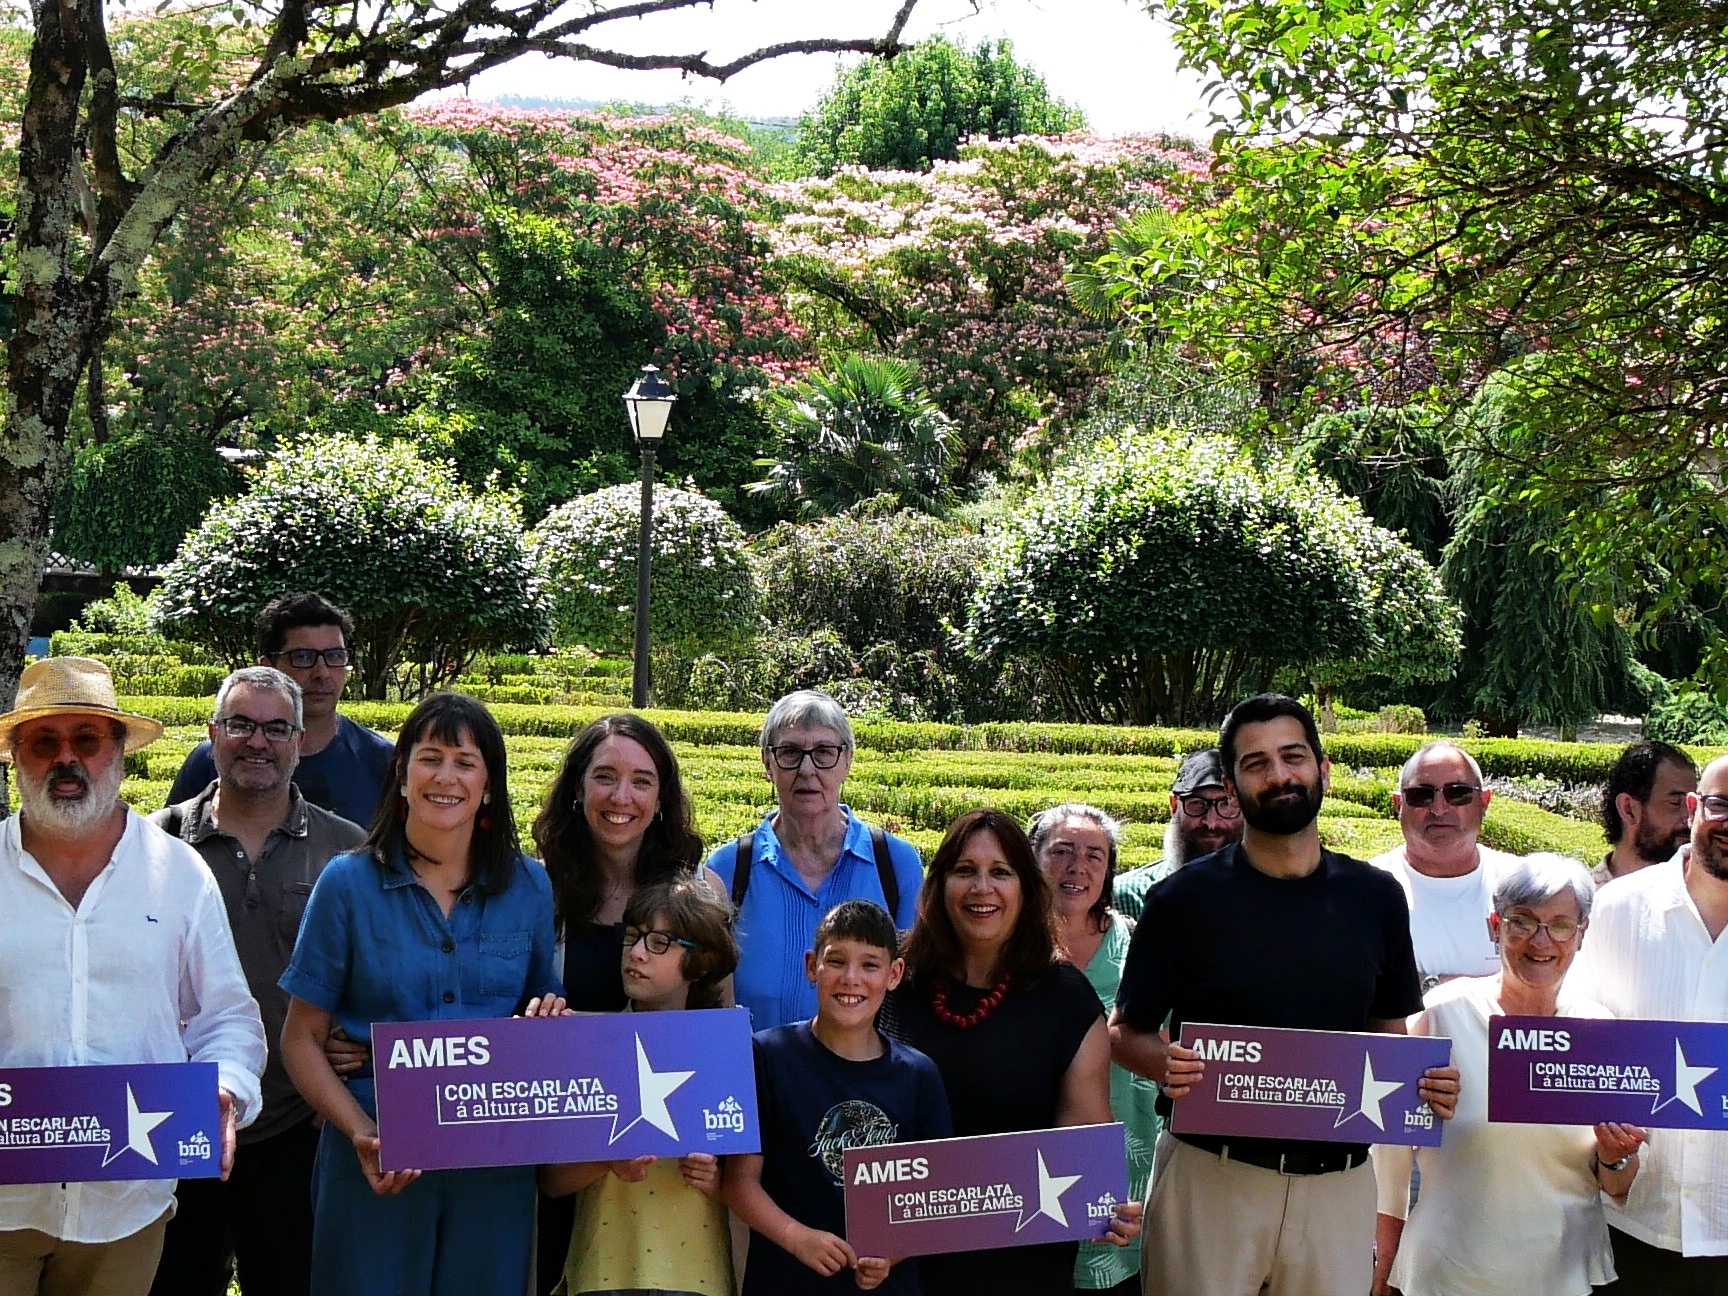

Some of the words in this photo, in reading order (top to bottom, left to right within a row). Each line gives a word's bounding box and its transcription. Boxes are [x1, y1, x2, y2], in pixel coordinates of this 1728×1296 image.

[1191, 1039, 1262, 1063] AMES
[1498, 1029, 1570, 1051] AMES
[389, 1036, 490, 1068] AMES
[1536, 1063, 1565, 1076] CON
[1569, 1064, 1650, 1078] ESCARLATA
[445, 1083, 486, 1102] CON
[492, 1078, 604, 1098] ESCARLATA
[1224, 1074, 1254, 1087] CON
[1258, 1076, 1337, 1092] ESCARLATA
[1543, 1075, 1551, 1086] á
[1555, 1075, 1595, 1088] altura
[1599, 1077, 1617, 1089] DE
[1620, 1078, 1660, 1090] AMES
[457, 1101, 467, 1117] á
[473, 1100, 529, 1117] altura
[534, 1097, 559, 1114] DE
[564, 1095, 618, 1112] AMES
[1230, 1086, 1238, 1098] á
[1242, 1087, 1282, 1101] altura
[1285, 1090, 1304, 1102] DE
[1306, 1091, 1346, 1104] AMES
[12, 1116, 100, 1131] ESCARLATA
[703, 1108, 744, 1134] bng
[1404, 1110, 1433, 1130] bng
[44, 1130, 64, 1143] DE
[67, 1129, 111, 1142] AMES
[178, 1140, 210, 1160] bng
[854, 1157, 929, 1185] AMES
[895, 1192, 925, 1207] CON
[929, 1184, 1013, 1203] ESCARLATA
[903, 1205, 911, 1218] á
[915, 1204, 957, 1217] altura
[960, 1199, 979, 1213] DE
[983, 1196, 1023, 1210] AMES
